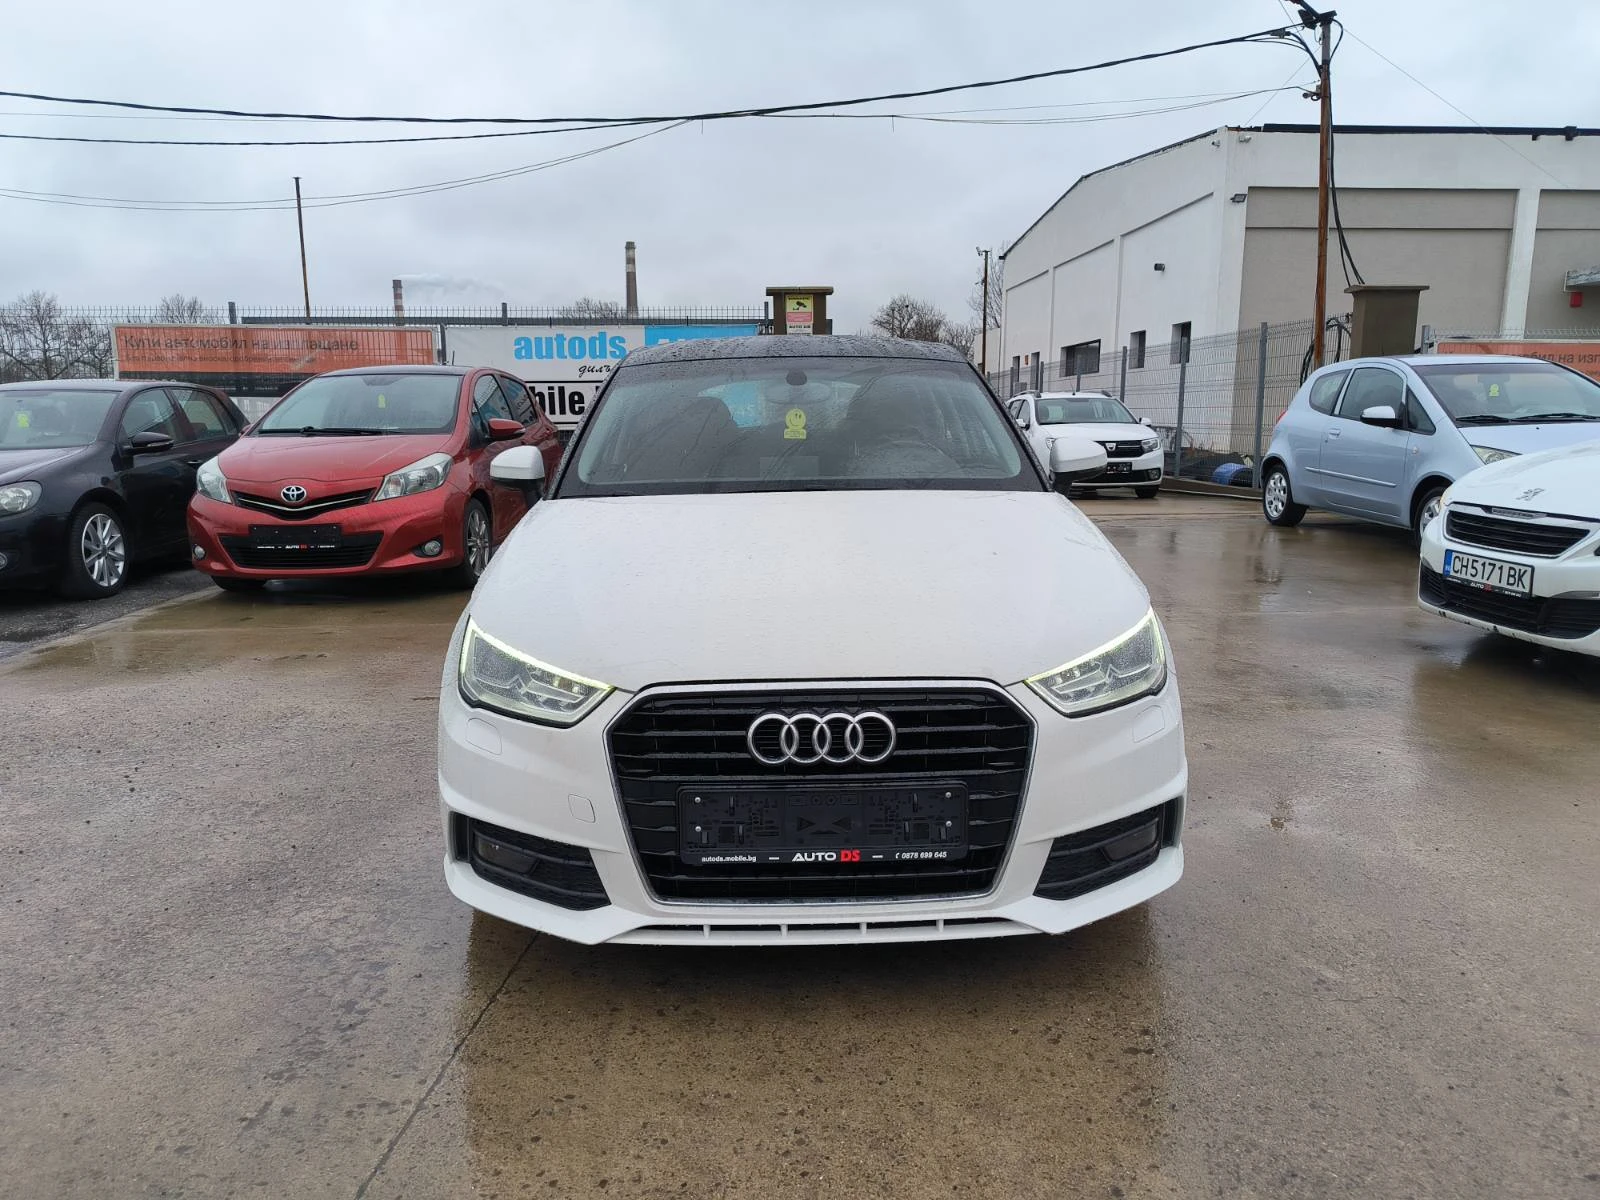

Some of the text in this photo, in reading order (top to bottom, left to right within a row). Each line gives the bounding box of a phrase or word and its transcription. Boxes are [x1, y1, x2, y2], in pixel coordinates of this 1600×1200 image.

[274, 339, 359, 352] излащане
[513, 331, 627, 360] autods
[1558, 354, 1574, 363] на
[1452, 555, 1528, 589] CH5171BK
[792, 851, 837, 863] AUTO
[840, 849, 861, 863] DS
